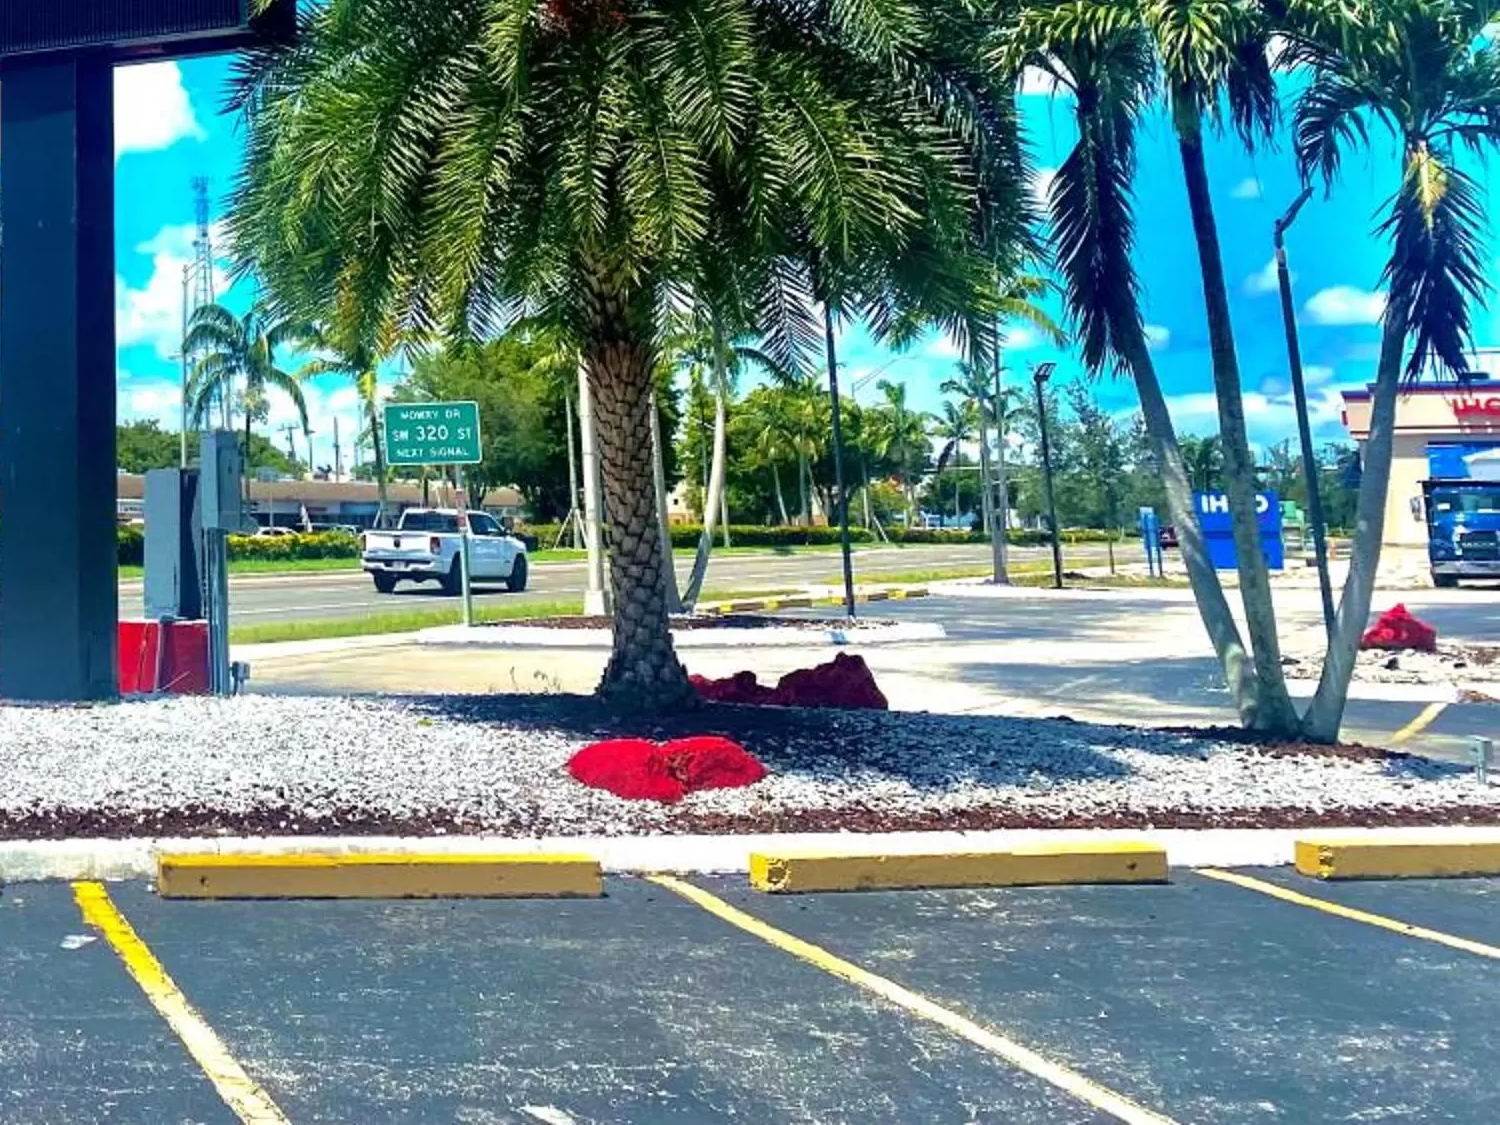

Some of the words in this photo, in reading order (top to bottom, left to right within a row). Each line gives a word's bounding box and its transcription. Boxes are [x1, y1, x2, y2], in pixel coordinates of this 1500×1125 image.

[445, 408, 461, 419] DR
[415, 425, 449, 442] 320
[457, 426, 471, 440] ST
[429, 446, 469, 457] SIGNAL
